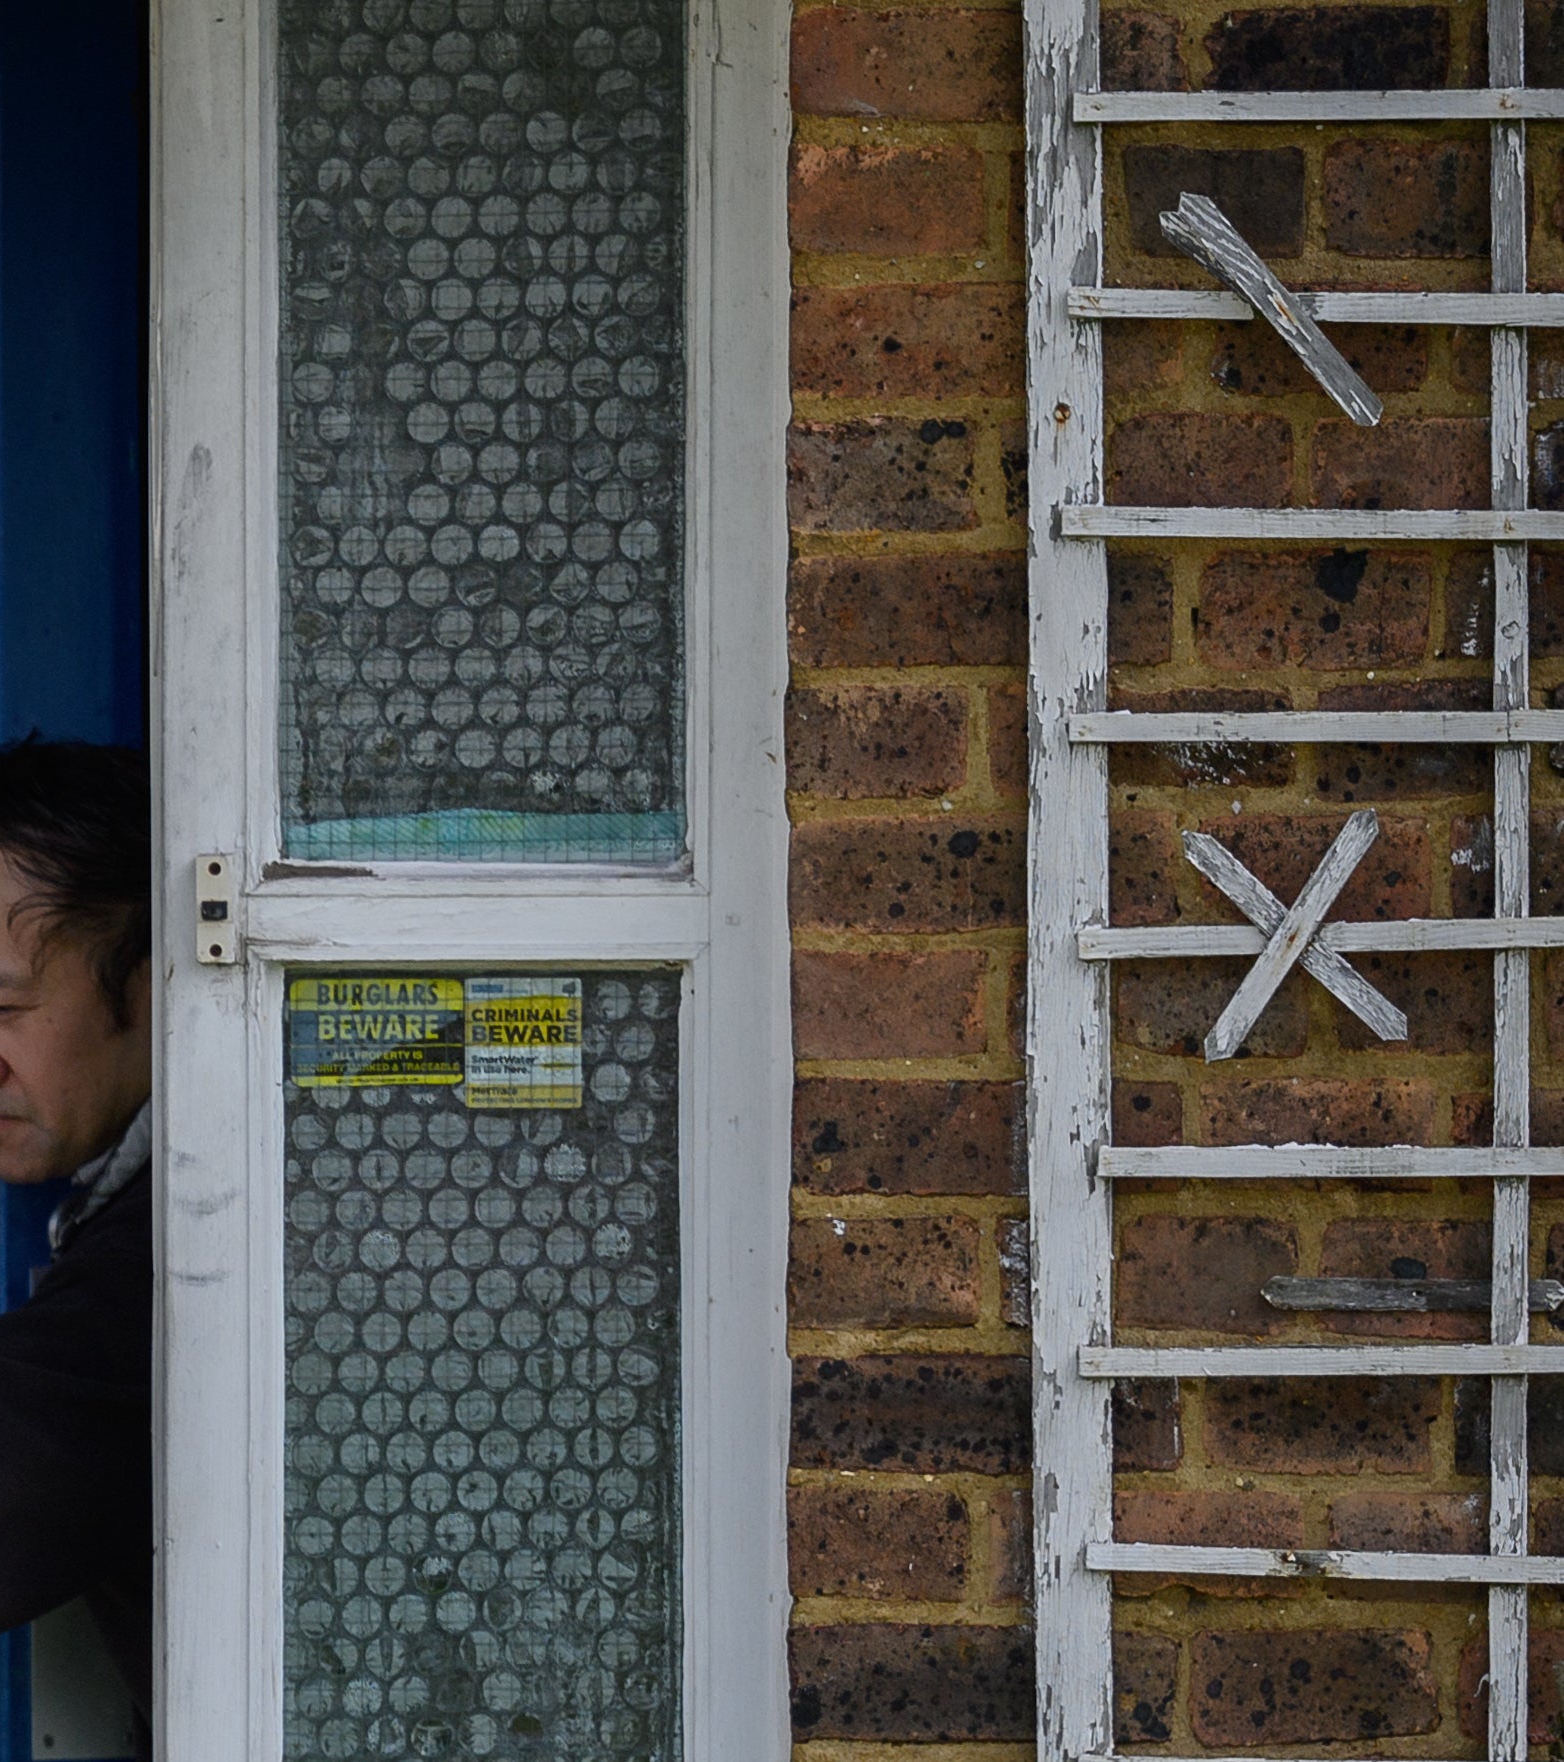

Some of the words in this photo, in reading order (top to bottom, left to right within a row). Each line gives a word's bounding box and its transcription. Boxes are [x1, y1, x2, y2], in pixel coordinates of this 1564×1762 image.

[317, 983, 439, 1006] BURGLARS
[472, 1008, 578, 1023] CRIMINALS
[317, 1014, 439, 1040] BEWARE
[472, 1025, 578, 1043] BEWARE
[354, 1050, 411, 1060] PROPERTY
[412, 1050, 423, 1060] IS
[402, 1061, 460, 1072] TRACEABLE
